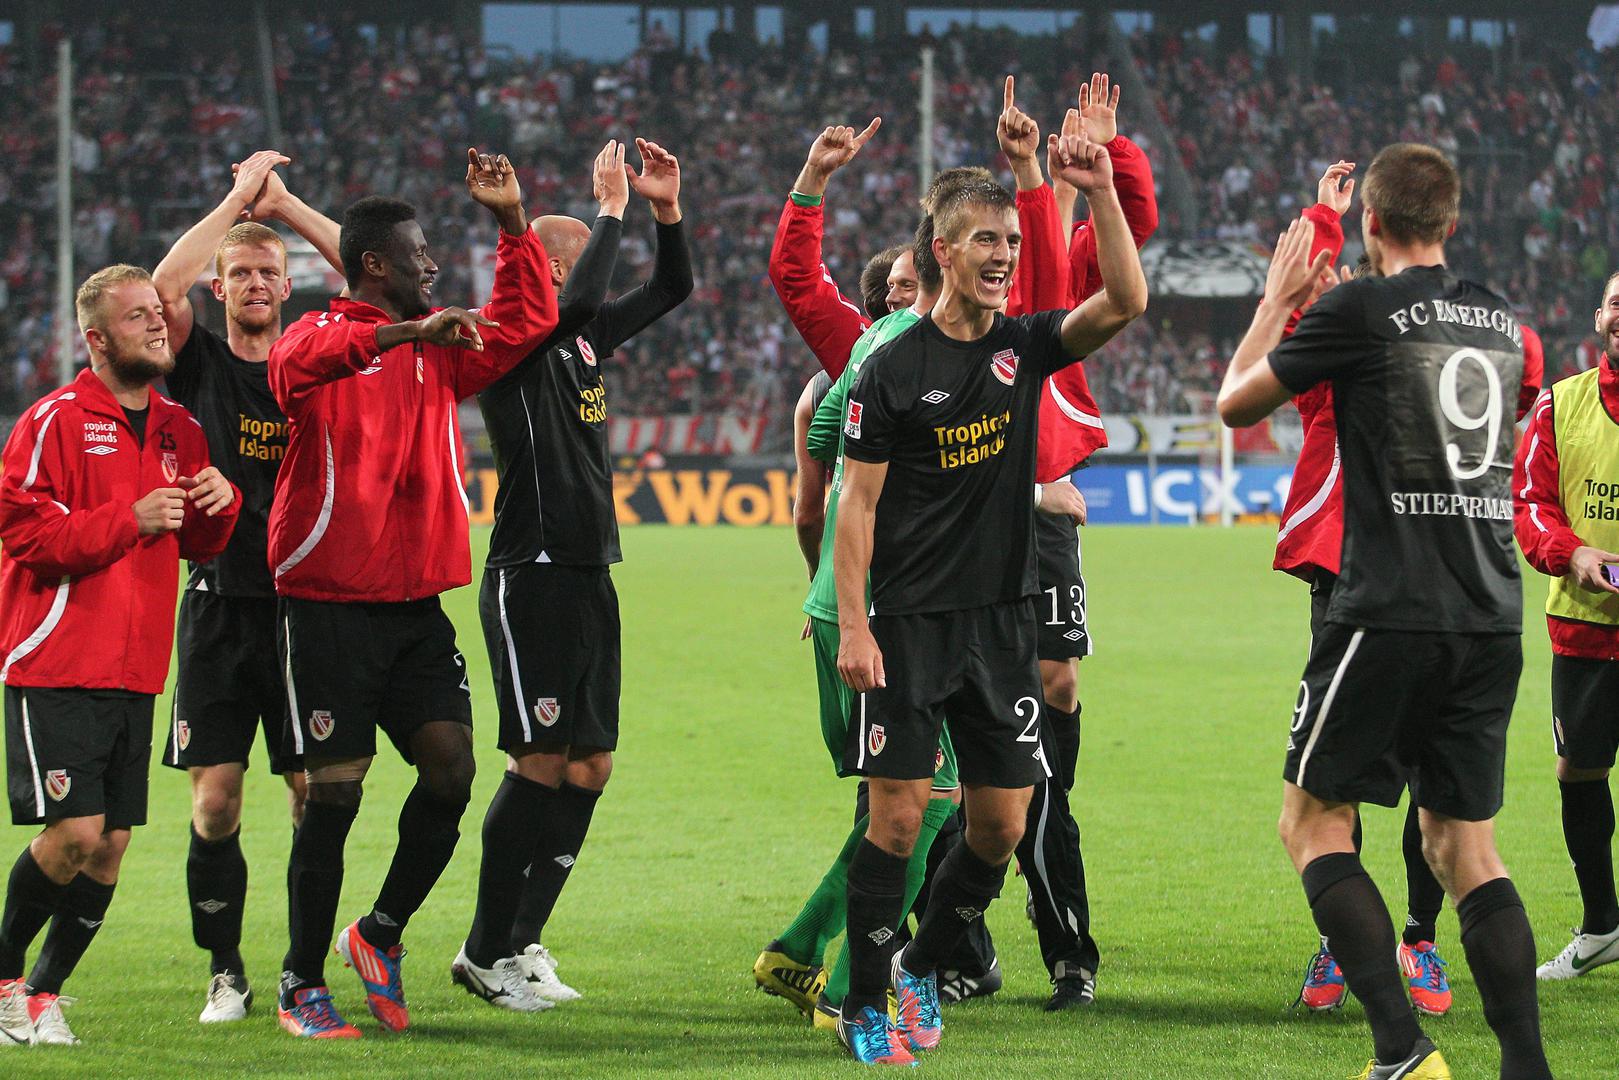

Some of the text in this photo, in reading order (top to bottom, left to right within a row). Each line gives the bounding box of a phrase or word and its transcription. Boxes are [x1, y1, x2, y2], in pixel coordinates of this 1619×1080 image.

[1389, 303, 1430, 335] FC
[1438, 347, 1503, 480] 9
[160, 431, 177, 451] 25
[1044, 584, 1085, 626] 13
[1014, 696, 1040, 743] 2
[1290, 680, 1310, 732] 9
